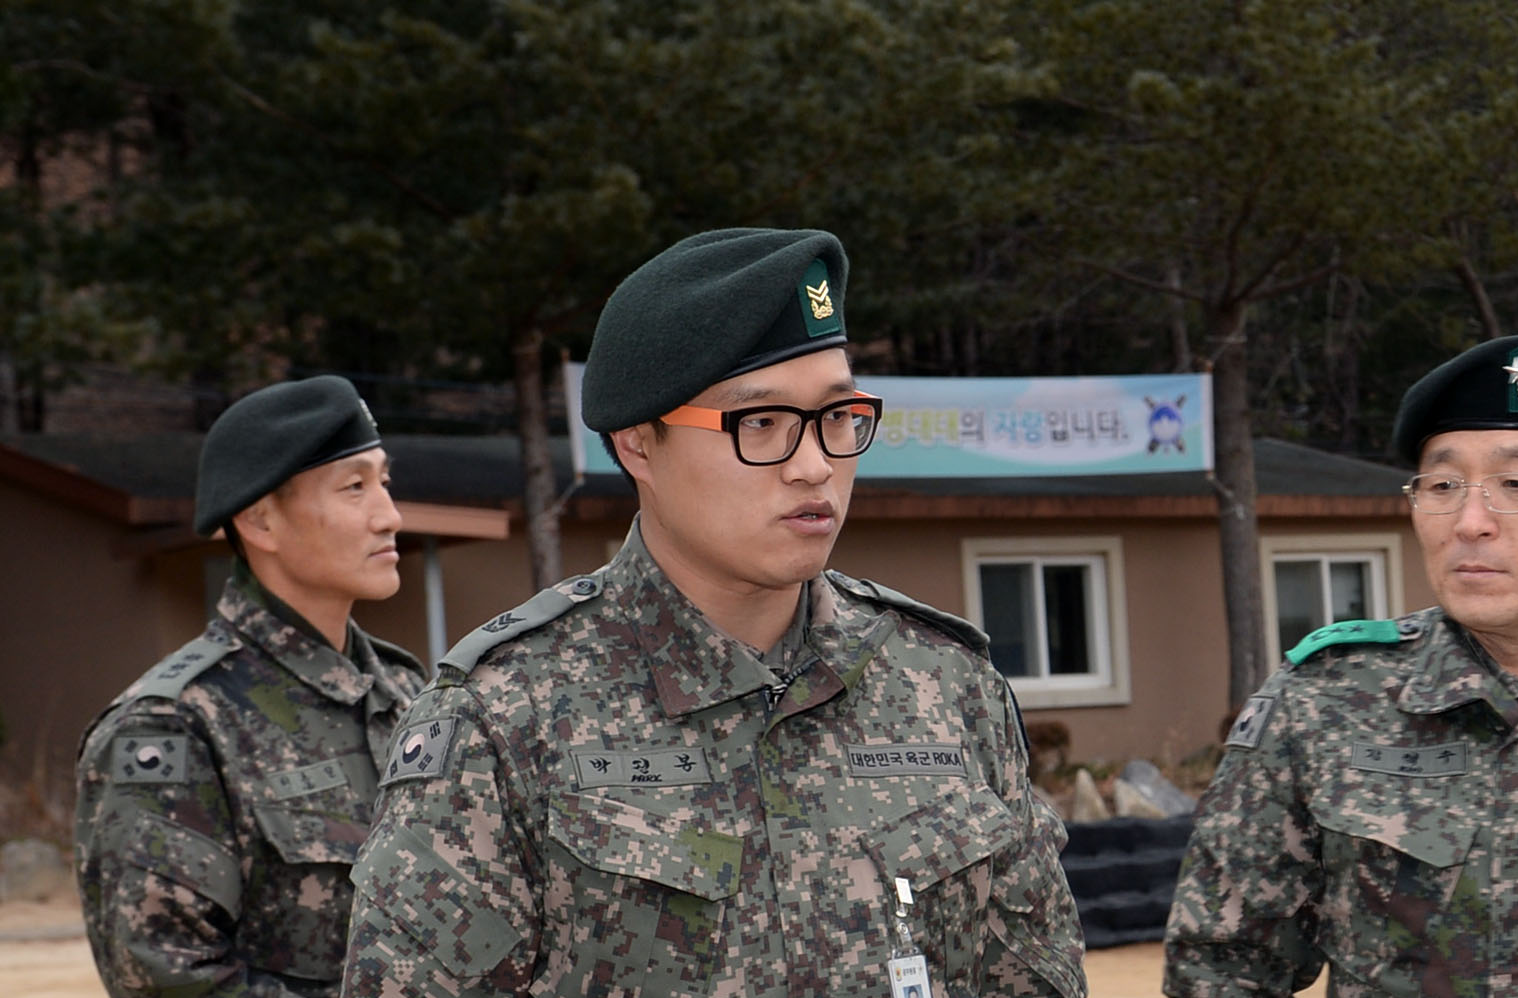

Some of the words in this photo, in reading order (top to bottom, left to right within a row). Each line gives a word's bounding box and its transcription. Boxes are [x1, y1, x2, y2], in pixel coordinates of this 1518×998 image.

[996, 410, 1128, 443] 자랑입니다.
[851, 752, 904, 767] 대한민국
[905, 751, 932, 766] 육군
[933, 752, 962, 766] ROKA
